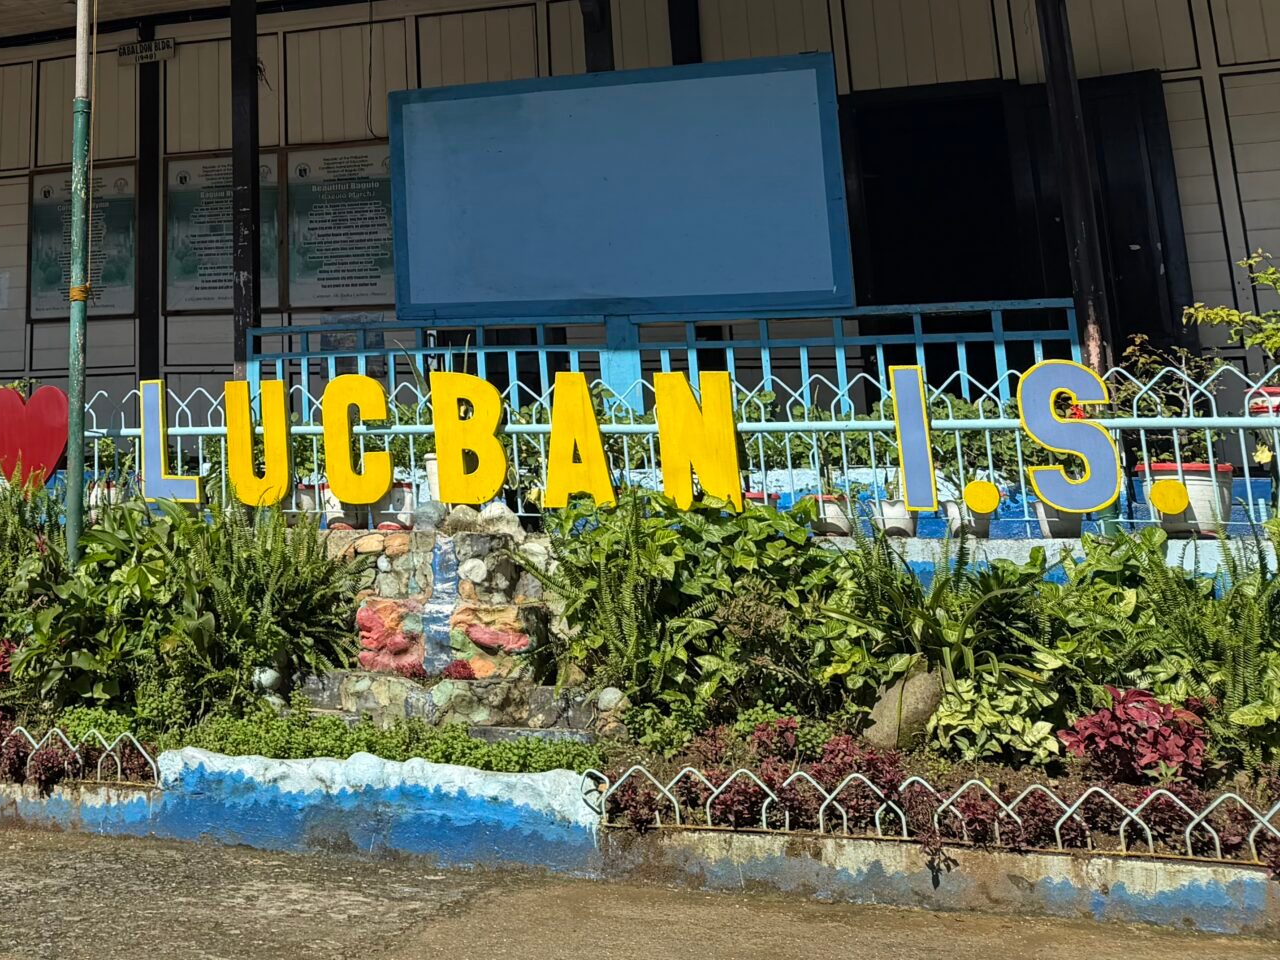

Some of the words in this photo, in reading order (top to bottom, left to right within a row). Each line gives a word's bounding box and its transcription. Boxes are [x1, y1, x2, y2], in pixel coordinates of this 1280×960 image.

[118, 41, 153, 57] GABALDON
[155, 40, 173, 51] BLDG.
[140, 371, 743, 514] LUCBAN
[889, 359, 1189, 514] I.S.
